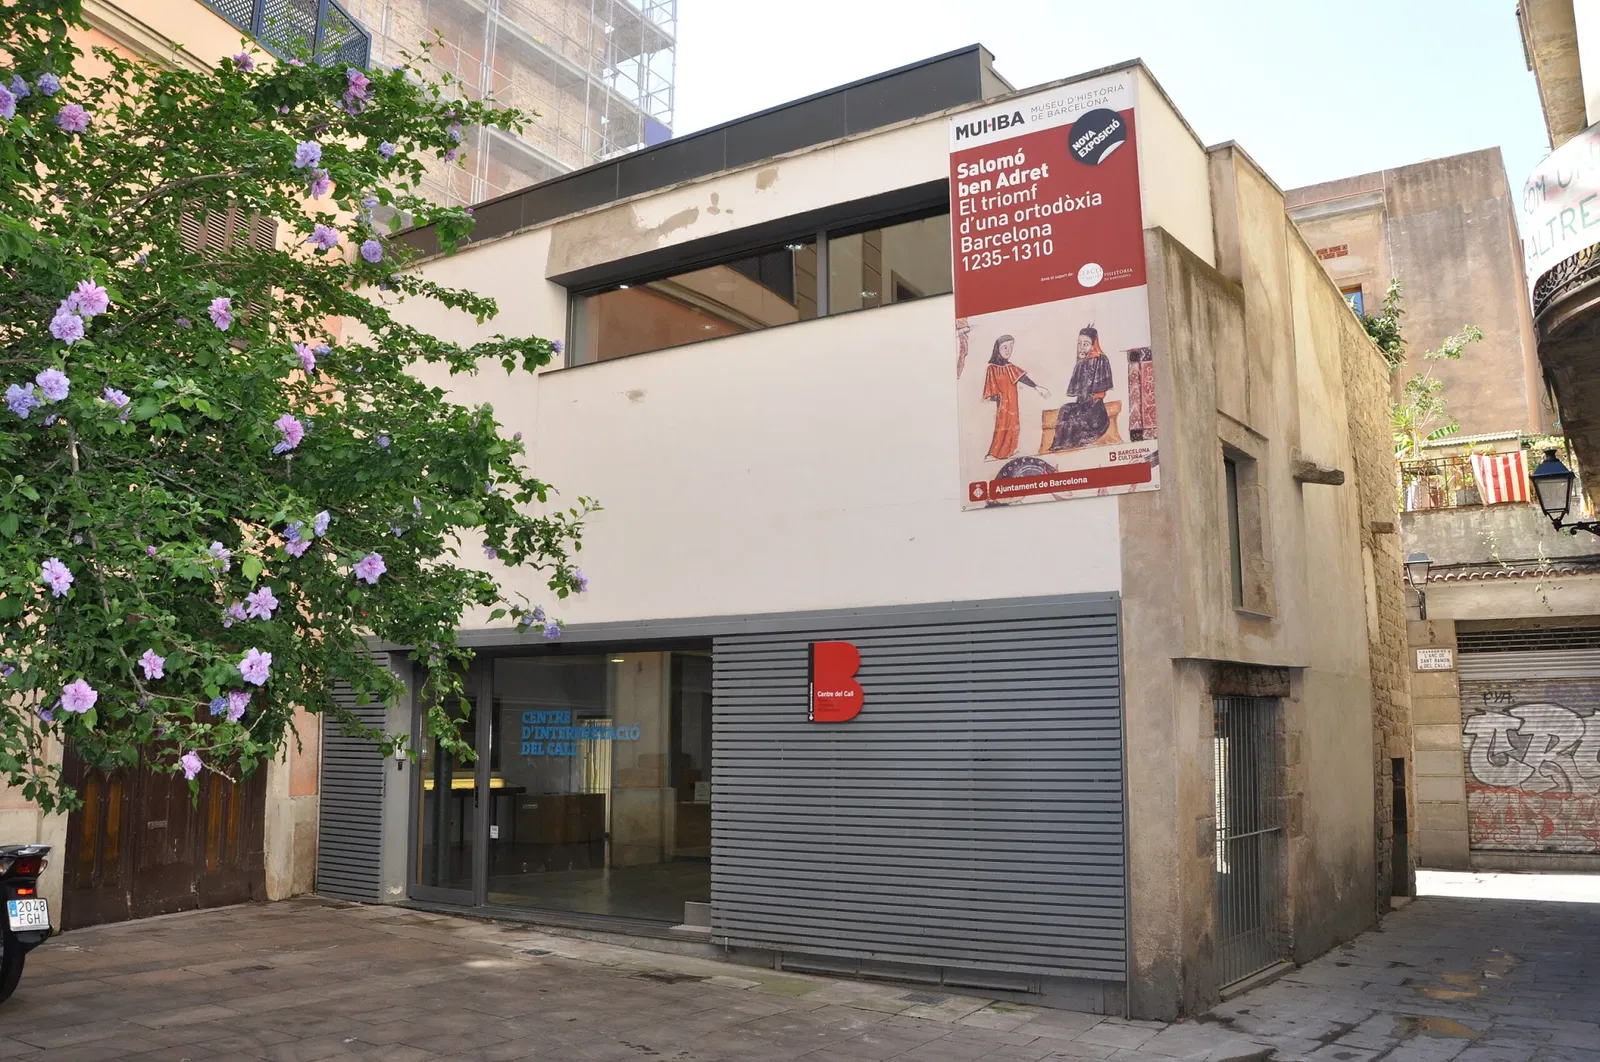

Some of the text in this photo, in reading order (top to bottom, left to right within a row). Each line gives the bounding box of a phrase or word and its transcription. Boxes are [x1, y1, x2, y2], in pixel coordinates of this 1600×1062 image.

[1030, 83, 1125, 114] MUSEU D'HISTÒRIA
[1031, 97, 1109, 122] DE BARCELONA
[1072, 129, 1097, 151] NOVA
[1077, 118, 1121, 158] EXPOSICIÓ
[957, 148, 1026, 179] Salomó
[958, 163, 1049, 198] ben Adret
[960, 184, 1038, 216] El triomf
[960, 191, 1103, 235] d'una ortodòxia
[961, 223, 1052, 254] Barcelona
[962, 239, 1054, 272] 1235-1310
[1118, 453, 1143, 461] CULTURA
[995, 476, 1088, 493] Ajuntament de Barcelona
[522, 710, 571, 724] CENTRE
[521, 723, 641, 741] D'INTERPRETACIÓ
[521, 742, 578, 756] DEL CALL
[18, 901, 46, 912] 2048
[19, 913, 41, 924] FGH
